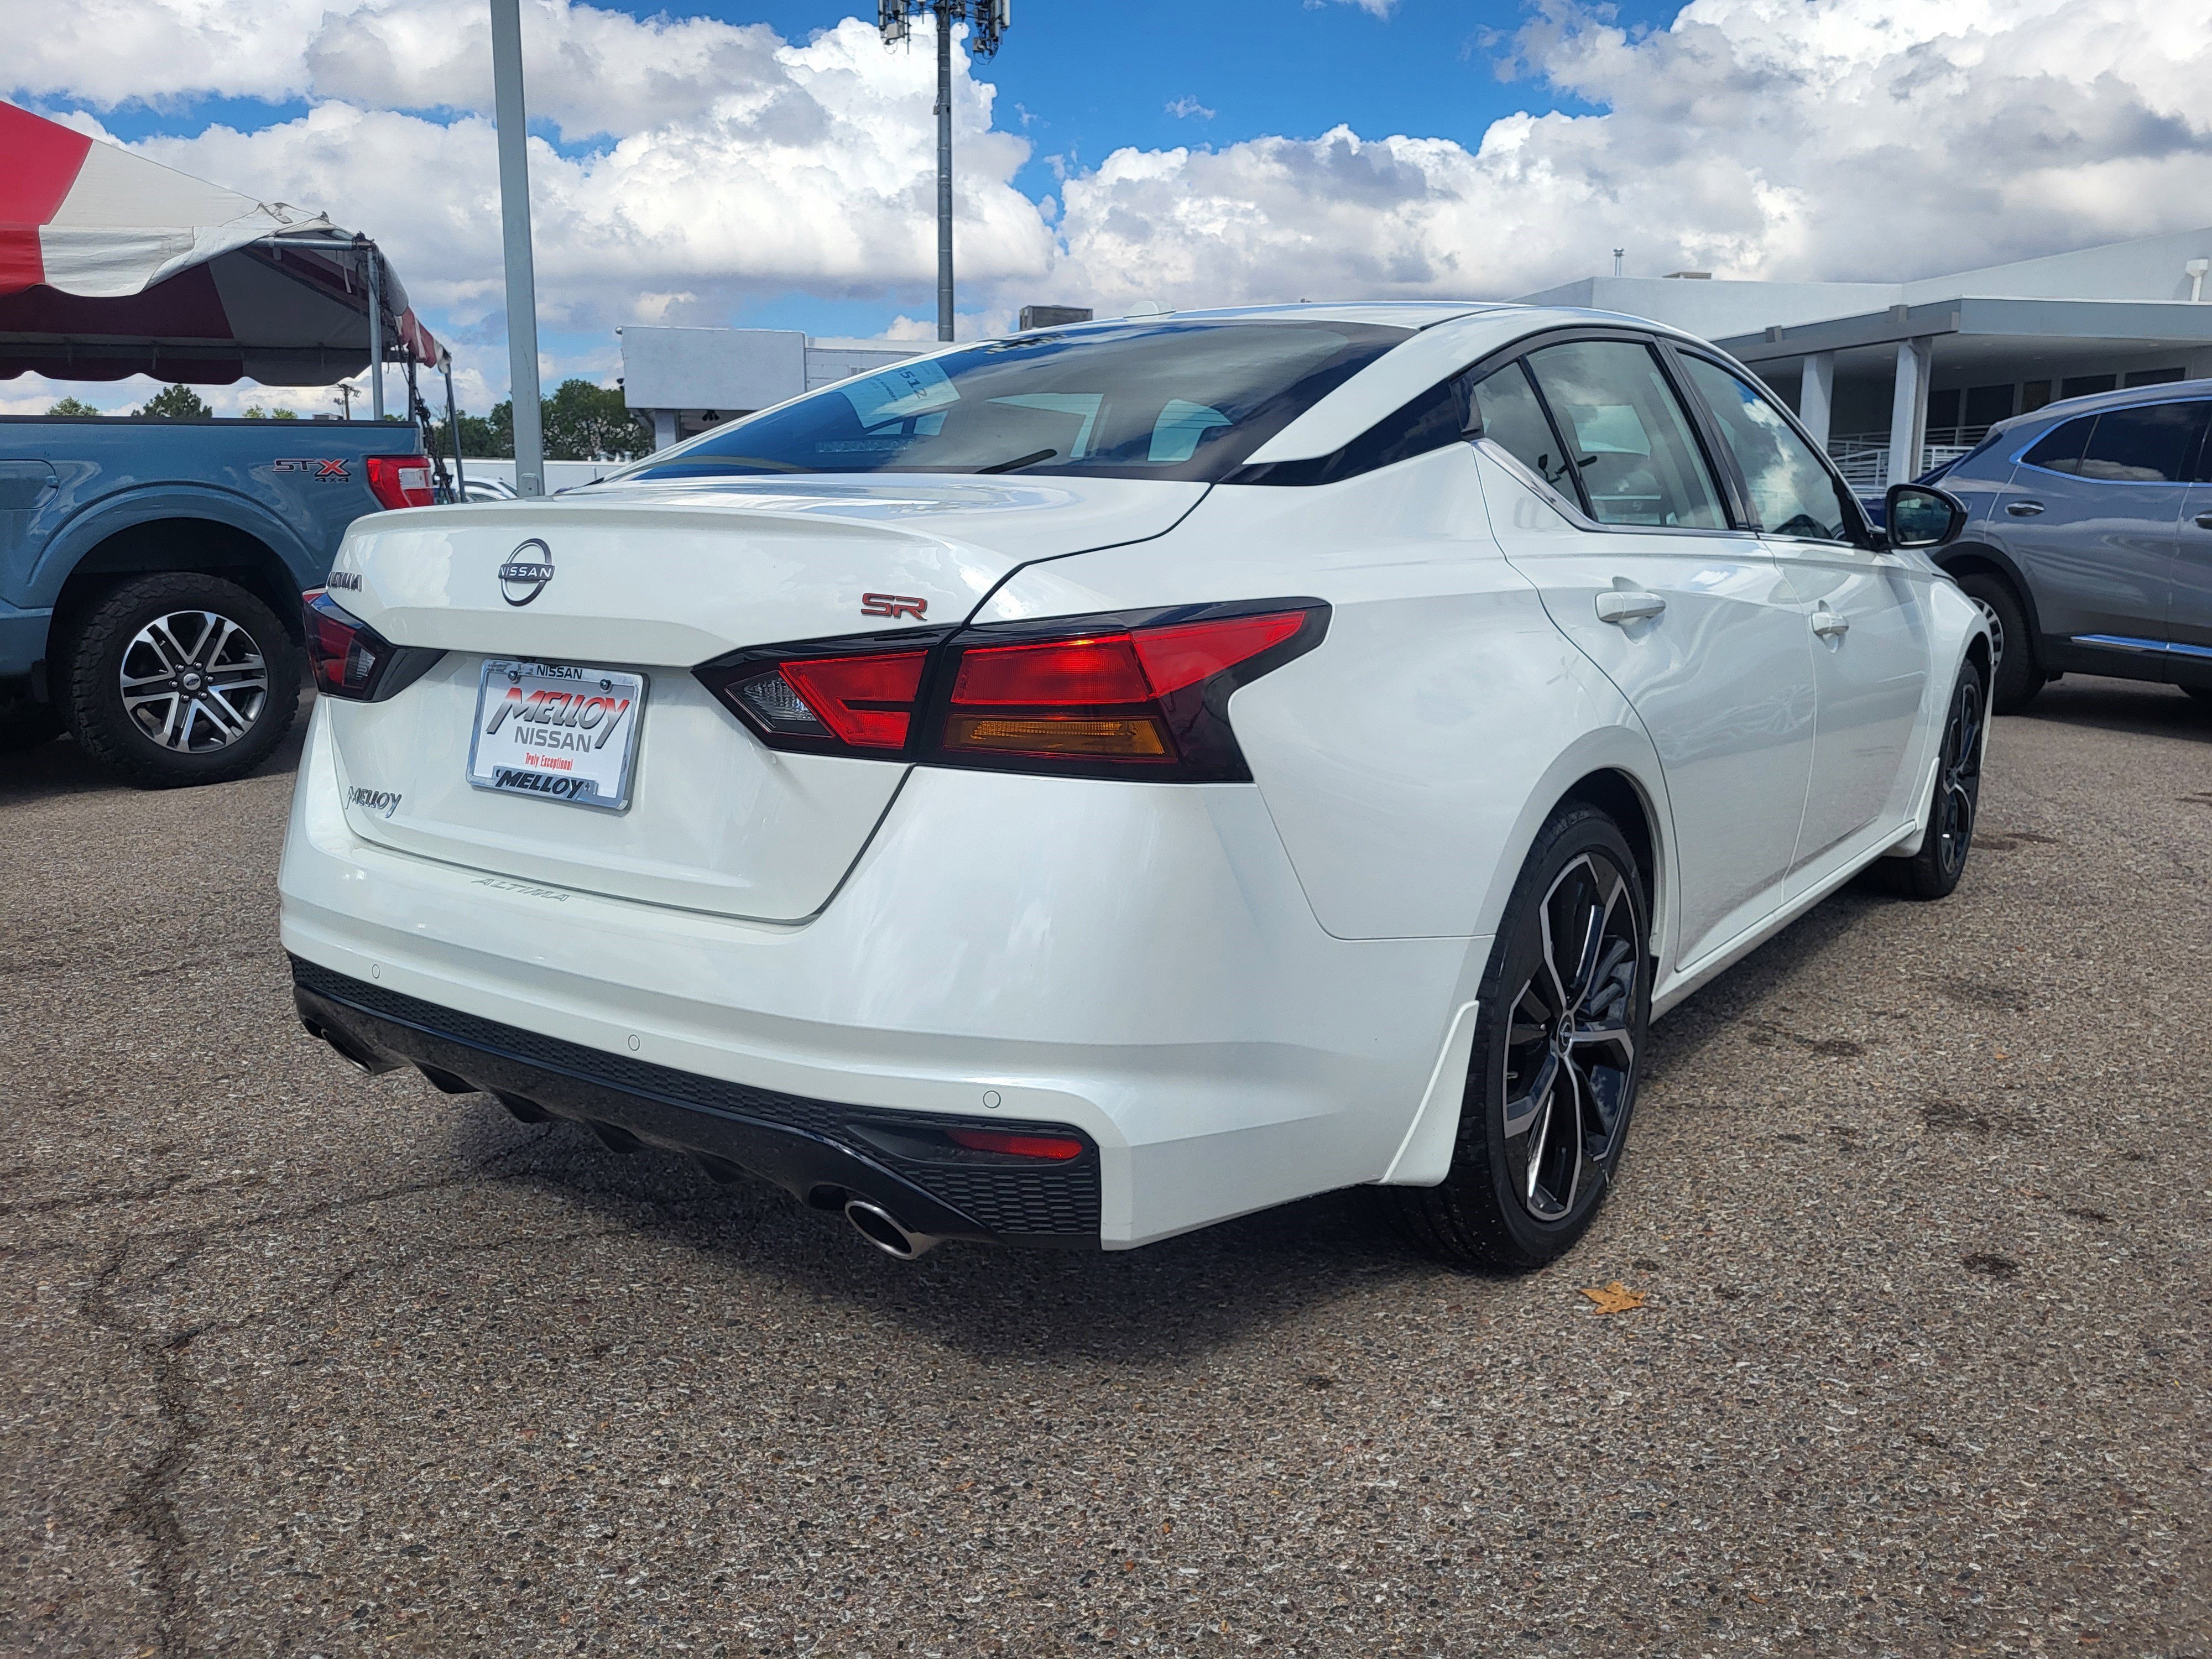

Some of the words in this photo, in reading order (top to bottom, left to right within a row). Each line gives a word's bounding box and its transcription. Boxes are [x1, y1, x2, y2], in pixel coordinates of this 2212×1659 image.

[273, 458, 352, 477] STX
[500, 566, 552, 578] NISSAN
[860, 593, 928, 621] SR
[536, 665, 583, 680] NISSAN
[486, 687, 630, 749] MELLOY
[514, 726, 592, 753] NISSAN
[525, 752, 540, 768] Truly
[540, 754, 573, 771] Exceptional
[495, 770, 584, 799] MELLOY
[345, 785, 403, 819] MELLOY
[470, 878, 571, 902] ALTIMA
